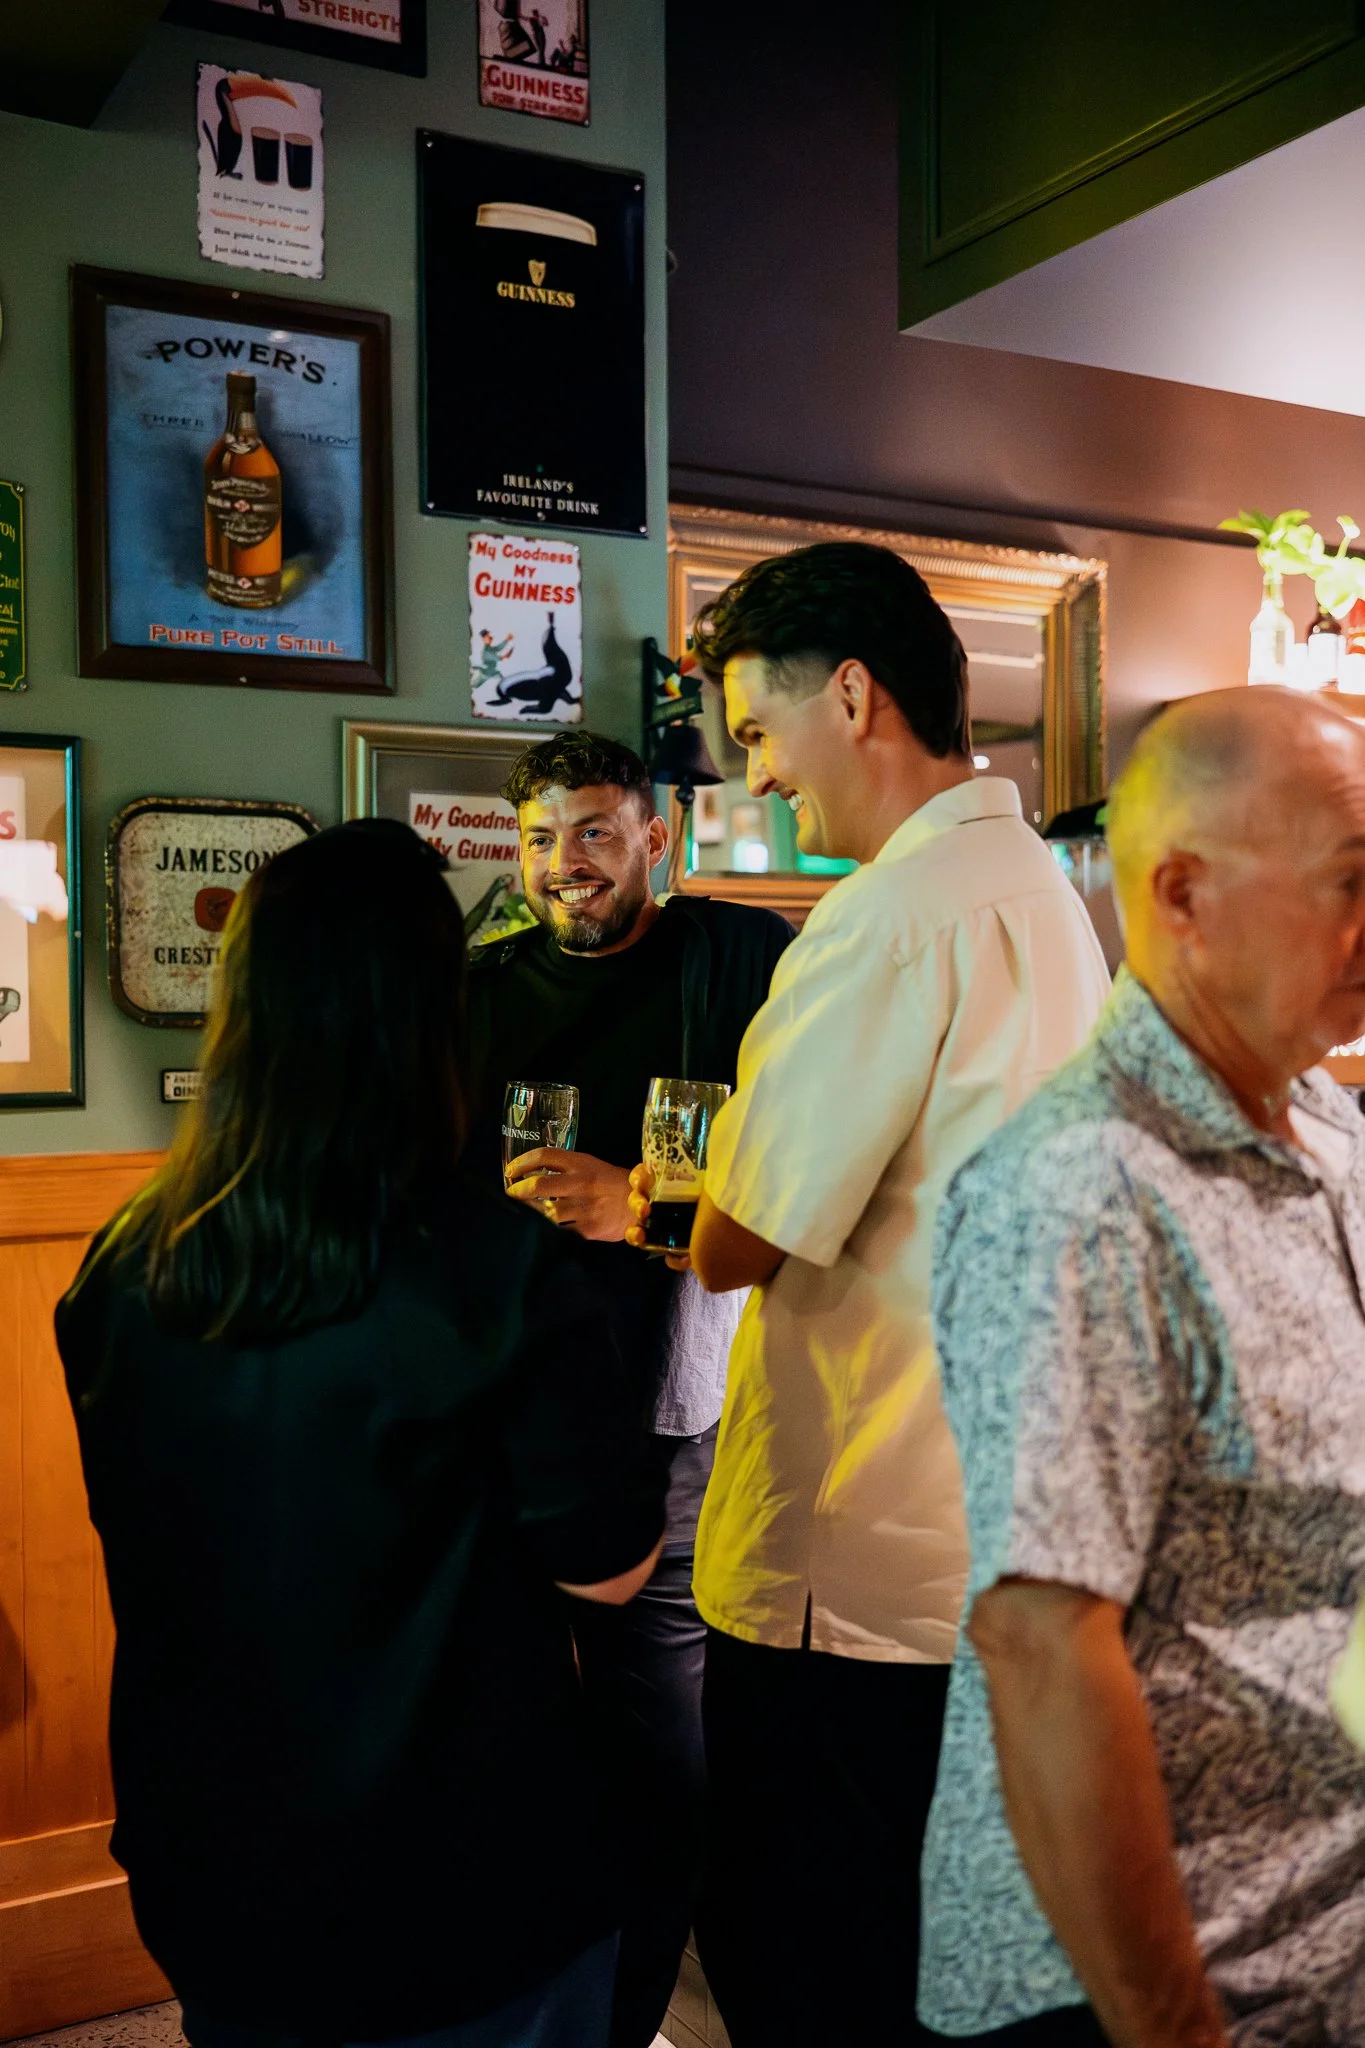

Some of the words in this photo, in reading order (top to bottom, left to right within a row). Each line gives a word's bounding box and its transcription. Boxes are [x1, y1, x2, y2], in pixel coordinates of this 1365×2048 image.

[298, 0, 402, 33] STRENGTH
[486, 64, 585, 105] GUINNESS
[497, 281, 575, 308] GUINNESS
[156, 337, 326, 384] POWER'S
[503, 473, 574, 494] IRELAND'S
[476, 489, 553, 510] FAVOURITE
[556, 498, 600, 516] DRINK
[475, 541, 497, 562] My
[502, 543, 573, 565] Goodness
[514, 564, 537, 579] MY
[475, 571, 577, 605] GUINNESS
[149, 624, 214, 645] PURE
[220, 629, 270, 649] POT
[277, 633, 344, 655] STILL
[413, 803, 444, 831] My
[447, 805, 520, 831] Goodne
[457, 838, 520, 862] GUINN
[154, 946, 221, 965] CREST
